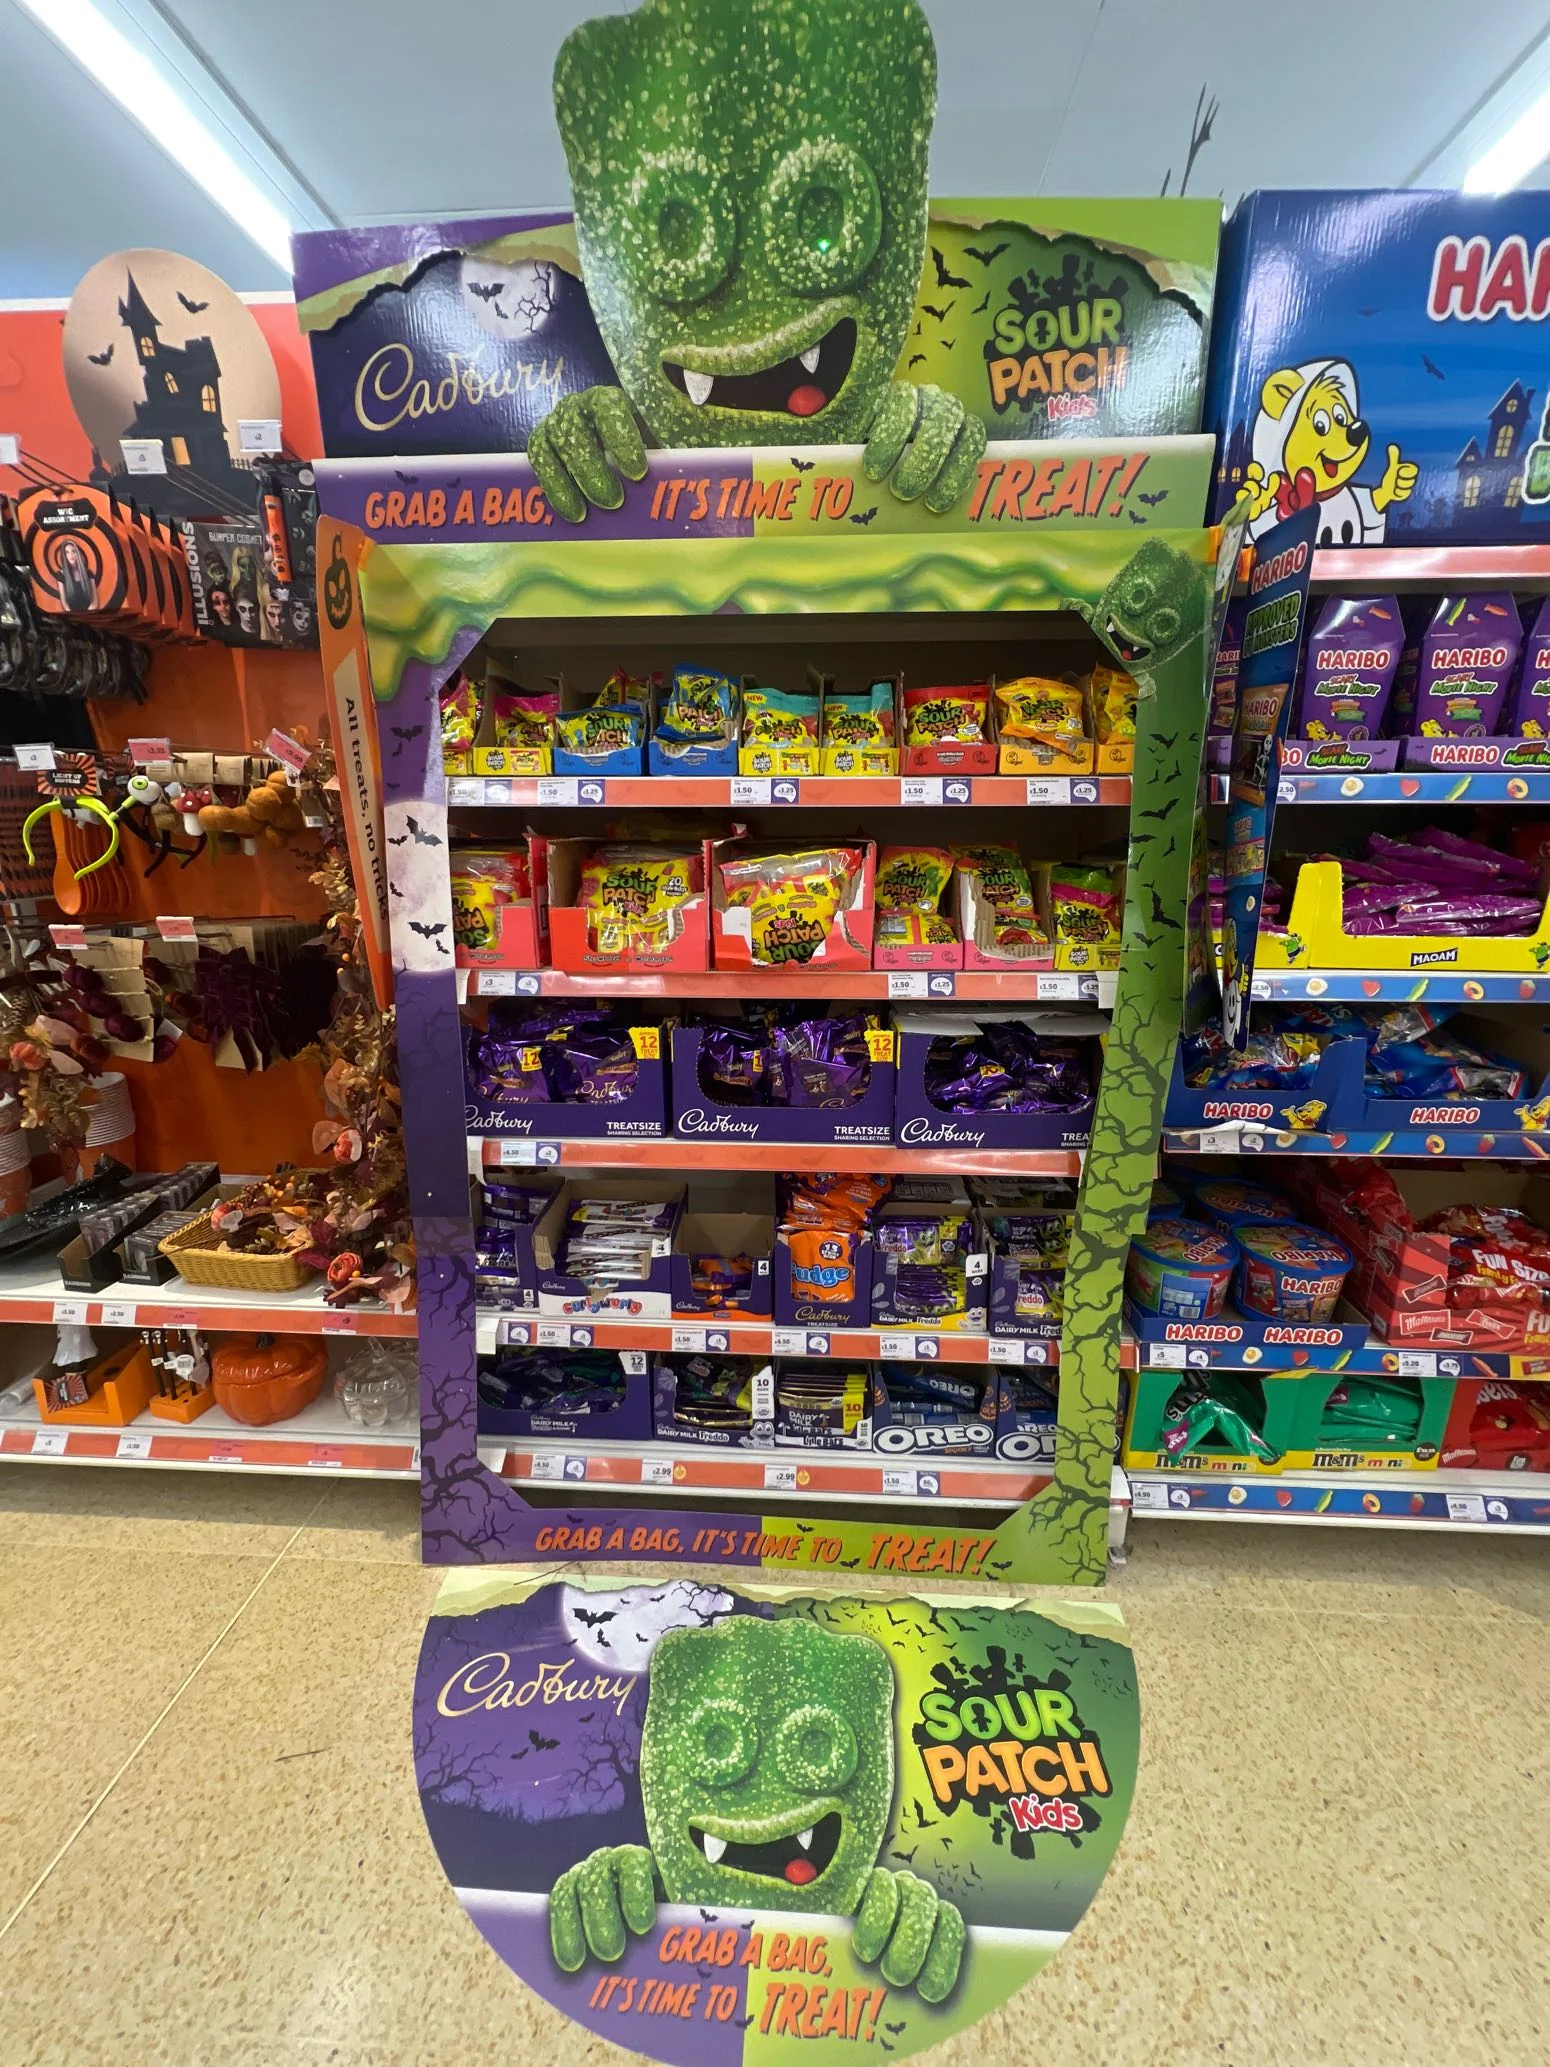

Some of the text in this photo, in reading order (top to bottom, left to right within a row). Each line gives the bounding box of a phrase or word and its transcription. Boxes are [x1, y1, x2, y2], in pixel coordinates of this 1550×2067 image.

[994, 299, 1123, 355] SOUR
[989, 347, 1128, 404] PATCH
[355, 343, 567, 432] Cadbury
[1047, 394, 1099, 421] Kids
[365, 451, 1152, 529] GRAB A BAG, IT'S TIME TO TREAT!
[182, 521, 209, 626] ILLUSIONS
[1251, 541, 1309, 595] HARIBO
[1317, 650, 1391, 670] HARIBO
[1432, 648, 1507, 669] HARIBO
[917, 706, 961, 724] SOUR
[1244, 697, 1279, 718] HARIBO
[916, 714, 966, 733] PATCH
[1431, 745, 1500, 765] HARIBO
[346, 697, 389, 922] All treats, no tricks
[606, 873, 658, 894] SOUR
[883, 882, 926, 898] PATCH
[602, 887, 657, 907] PATCH
[763, 921, 826, 948] PATCH
[1412, 949, 1457, 965] MAOAM
[640, 1036, 658, 1049] 12
[873, 1039, 891, 1051] 12
[523, 1052, 540, 1067] 12
[465, 1105, 533, 1134] Cadbury
[1204, 1102, 1273, 1119] HARIBO
[1410, 1107, 1480, 1124] HARIBO
[606, 1121, 661, 1130] TREATSIZE
[678, 1108, 760, 1138] Cadbury
[834, 1126, 890, 1135] TREATSIZE
[901, 1117, 985, 1147] Cadbury
[1062, 1132, 1090, 1141] TREA
[760, 1262, 768, 1271] 4
[974, 1261, 981, 1269] 4
[524, 1290, 532, 1298] 4
[1281, 1276, 1343, 1295] HARIBO
[795, 1306, 850, 1324] Cadbury
[994, 1326, 1017, 1334] DAIRY
[1165, 1323, 1243, 1342] HARIBO
[1264, 1327, 1343, 1345] HARIBO
[757, 1379, 769, 1387] 10
[929, 1379, 976, 1398] OREO
[789, 1411, 818, 1420] DAIRY
[845, 1403, 861, 1412] 10
[657, 1428, 730, 1443] DAIRY MILK Freddo
[876, 1425, 991, 1453] OREO
[652, 1467, 672, 1476] £2.99
[776, 1472, 796, 1481] £2.99
[535, 1527, 998, 1576] GRAB A BAG, IT'S TIME TO TREAT!
[436, 1652, 637, 1717] Cadbury
[918, 1689, 1082, 1741] SOUR
[920, 1740, 1110, 1803] PATCH
[1009, 1796, 1083, 1834] Kids
[659, 1926, 833, 1977] GRAB A BAG,
[589, 1976, 888, 2043] IT'S TIME TO TREAT!
